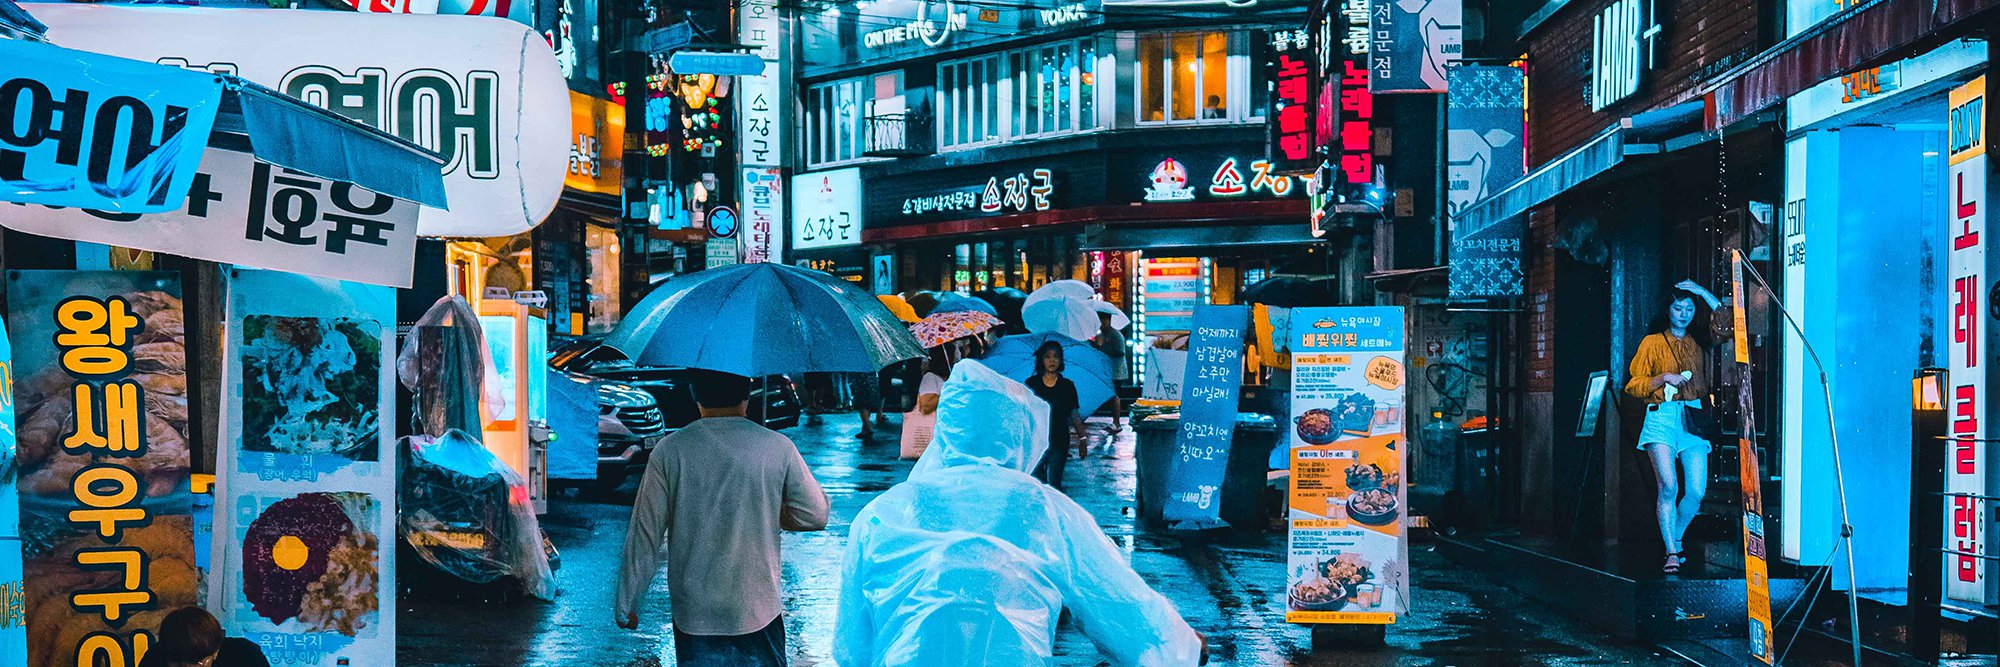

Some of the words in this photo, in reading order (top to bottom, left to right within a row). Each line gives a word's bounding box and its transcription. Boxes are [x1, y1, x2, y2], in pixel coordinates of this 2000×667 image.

[884, 27, 906, 45] THE
[1373, 2, 1393, 79] 전문점
[1441, 44, 1461, 54] LAMB
[749, 93, 771, 162] 소장군
[1951, 95, 1982, 157] BMW
[903, 191, 976, 214] 소갈비살전문점
[981, 168, 1053, 212] 소장군
[803, 211, 850, 241] 소장군
[1198, 326, 1238, 341] 언제까지
[1195, 346, 1237, 363] 삼겹살에
[1198, 366, 1230, 382] 소주만
[1954, 171, 1978, 583] 노래클럽
[1192, 386, 1229, 403] 마실래!
[1183, 422, 1228, 441] 양꼬치엔
[259, 635, 288, 649] 육회
[293, 634, 322, 649] 낙지
